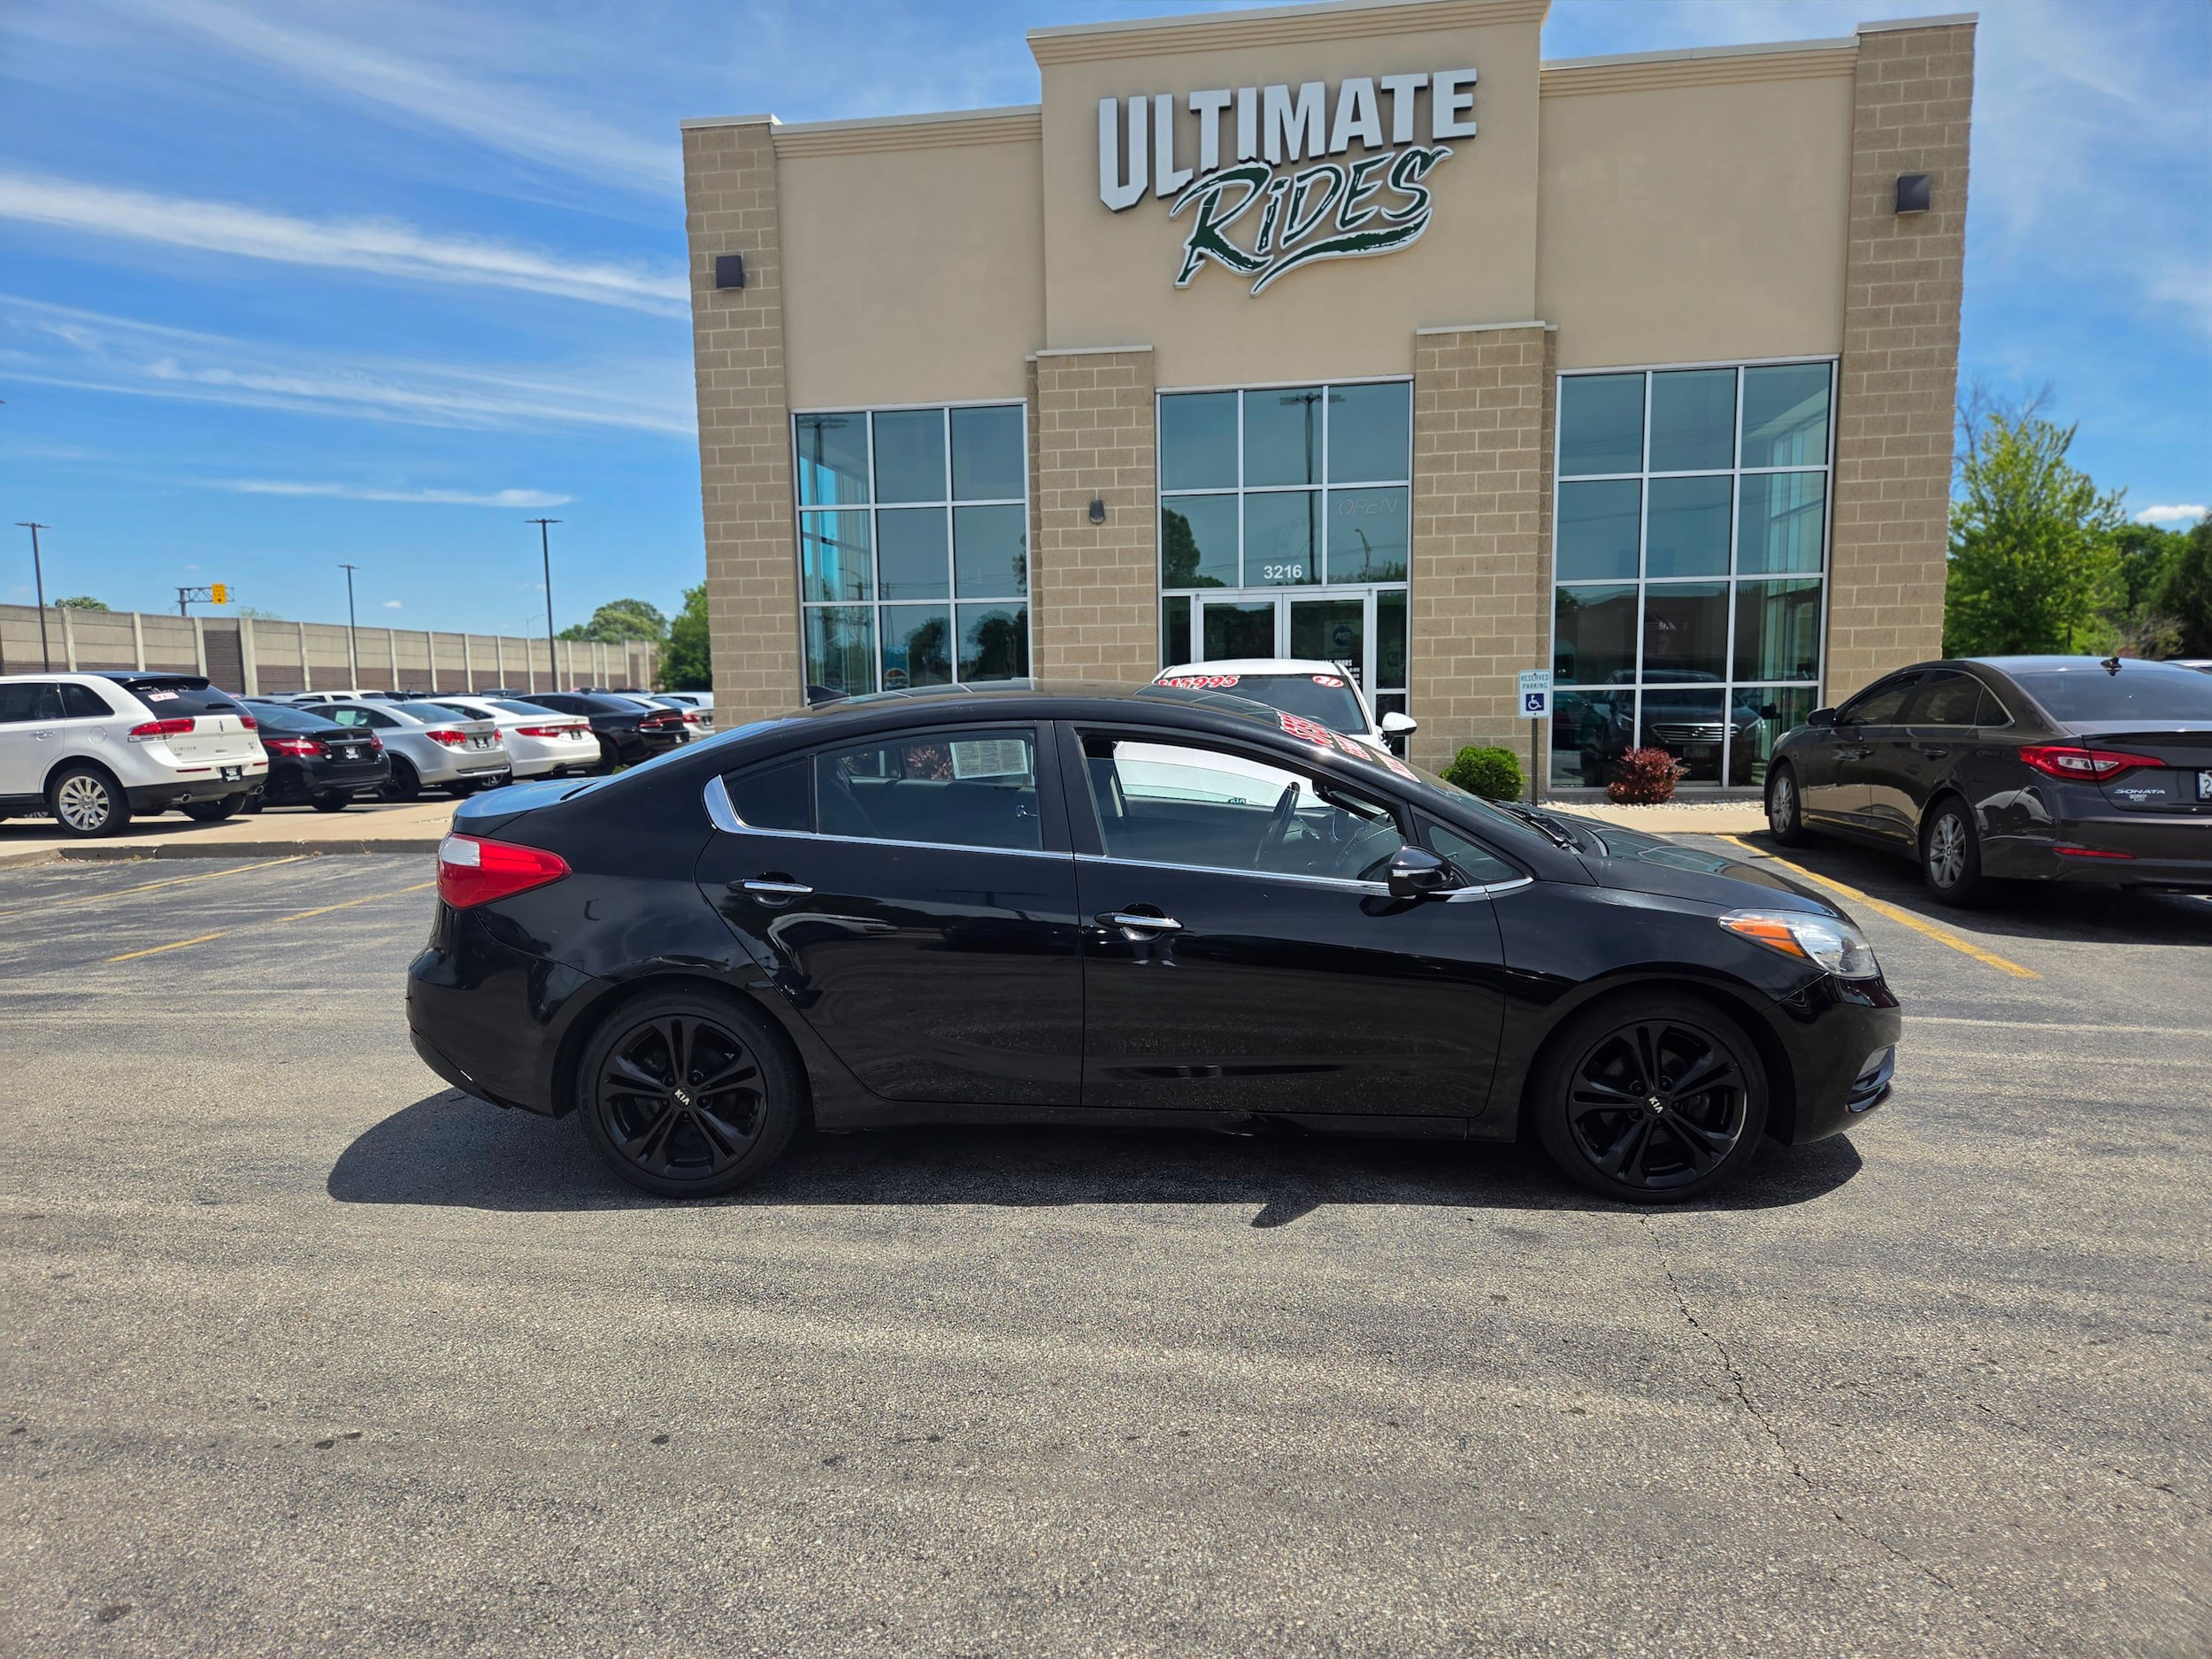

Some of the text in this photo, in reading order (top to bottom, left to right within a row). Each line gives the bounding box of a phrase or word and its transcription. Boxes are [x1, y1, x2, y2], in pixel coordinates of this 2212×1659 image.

[1099, 68, 1478, 213] ULTIMATE
[1337, 496, 1399, 516] OPEN
[1263, 564, 1302, 580] 3216
[674, 1088, 690, 1106] KIA
[1648, 1095, 1663, 1114] KIA
